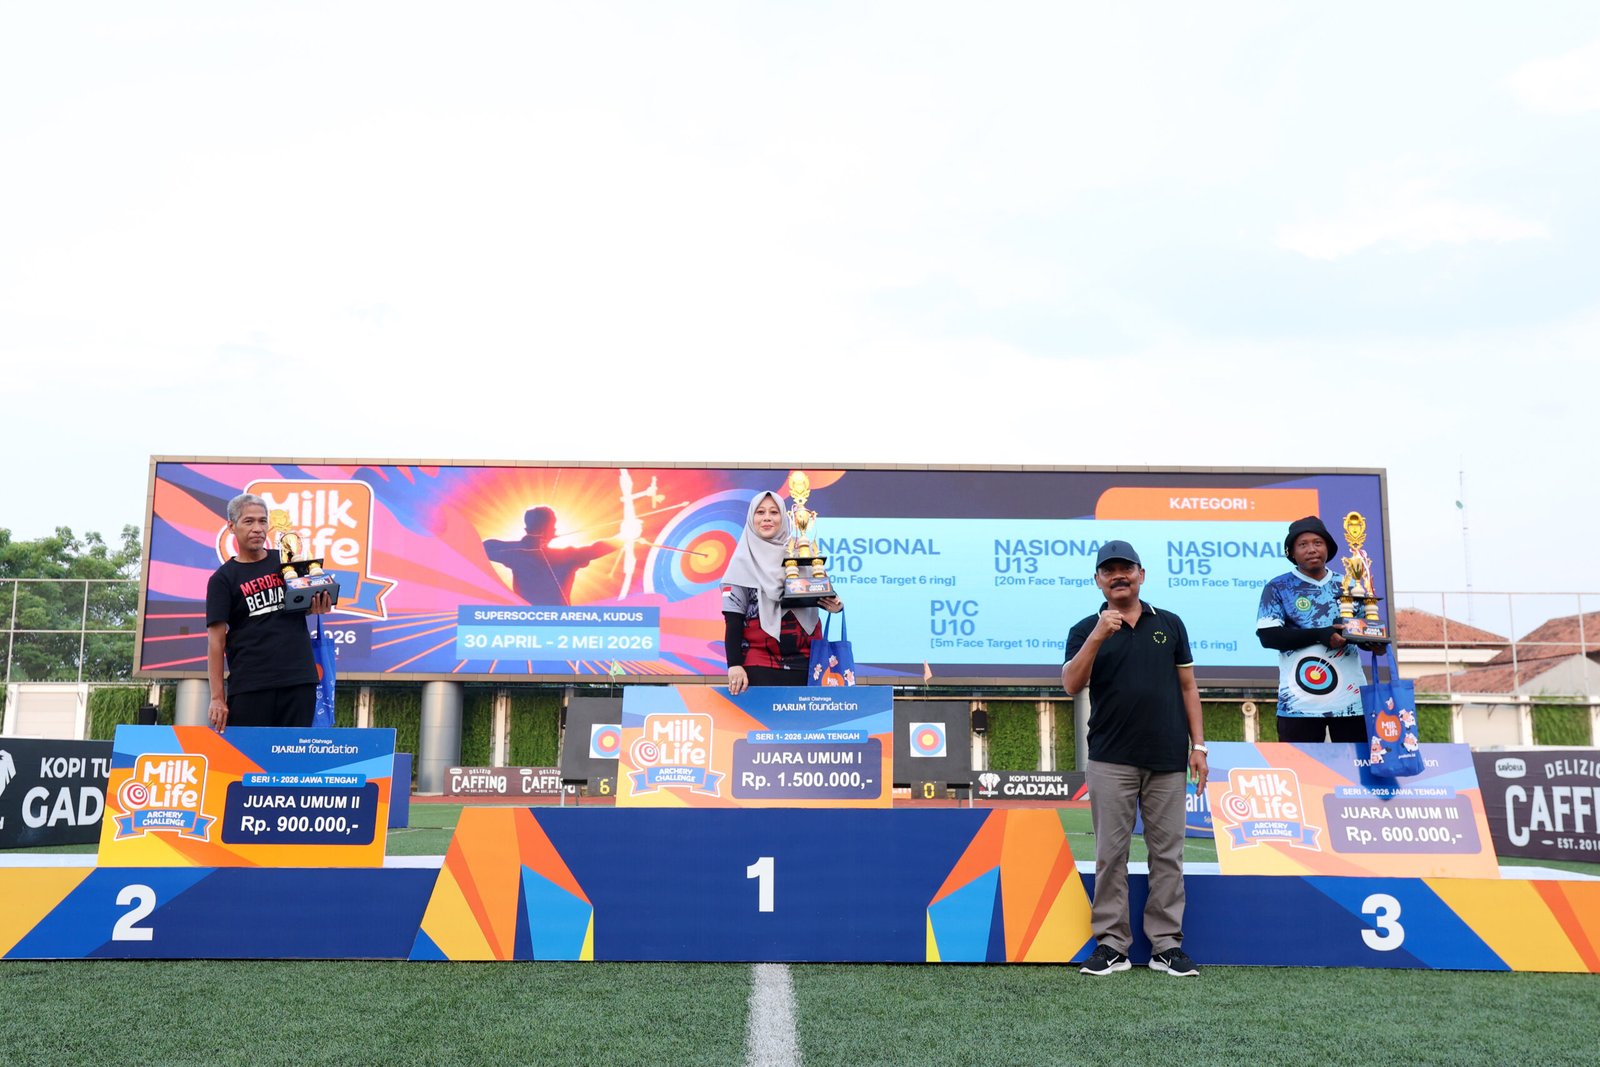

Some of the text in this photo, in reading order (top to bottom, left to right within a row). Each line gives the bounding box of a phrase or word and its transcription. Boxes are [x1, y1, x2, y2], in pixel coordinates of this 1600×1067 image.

[261, 490, 357, 528] Milk
[1169, 498, 1247, 509] KATEGORI
[278, 528, 360, 566] ife
[819, 538, 940, 555] NASIONAL
[994, 539, 1105, 556] NASIONA
[1166, 541, 1287, 558] NASIONAL
[994, 557, 1038, 573] U13
[1167, 558, 1212, 575] U15
[850, 575, 877, 584] Face
[880, 575, 916, 586] Target
[919, 575, 927, 585] 6
[930, 575, 956, 587] ring]
[994, 576, 1094, 587] [20m Face Target
[1168, 577, 1199, 588] [30m
[1202, 578, 1229, 587] Face
[930, 600, 979, 617] PVC
[474, 611, 643, 623] SUPERSOCCER ARENA, KUDUS
[930, 619, 975, 636] U10
[464, 634, 487, 649] 30
[491, 635, 542, 649] APRIL
[557, 635, 568, 649] 2
[572, 636, 603, 649] MEI
[607, 636, 653, 650] 2026
[930, 638, 1065, 650] [5m Face Target 10 ring
[1200, 640, 1208, 649] 6
[1210, 640, 1237, 651] ring]
[773, 702, 858, 712] DJARUM foundation
[653, 719, 704, 742] Milk
[271, 743, 359, 754] DJARUM foundation
[660, 742, 706, 765] Life
[752, 751, 862, 764] JUARA UMUM I
[40, 757, 86, 778] KOPI
[143, 760, 198, 784] Milk
[659, 767, 693, 776] ARCHERY
[251, 776, 270, 784] SERI
[281, 776, 299, 784] 2026
[300, 776, 323, 784] JAWA
[452, 775, 507, 793] CAFFINO
[600, 778, 610, 795] 6
[655, 774, 696, 783] CHALLENGE
[742, 771, 873, 790] Rp. 1.500.000,-
[1009, 775, 1028, 783] KOPI
[1238, 774, 1293, 797] Milk
[149, 784, 198, 808] Life
[923, 783, 935, 799] 0
[1003, 783, 1068, 796] GADJAH
[1372, 788, 1389, 796] 2026
[1391, 788, 1413, 796] JAWA
[1415, 788, 1447, 796] TENGAH
[22, 786, 104, 829] GAD
[243, 795, 360, 809] JUARA UMUM II
[1251, 796, 1298, 819] Life
[147, 810, 183, 819] ARCHERY
[1340, 806, 1459, 819] JUARA UMUM III
[142, 817, 185, 827] CHALLENGE
[240, 816, 359, 835] Rp. 900.000,-
[1252, 829, 1293, 837] CHALLENGE
[1346, 826, 1463, 845] Rp. 600.000,-
[747, 856, 774, 912] 1
[111, 884, 156, 942] 2
[1360, 893, 1405, 952] 3
